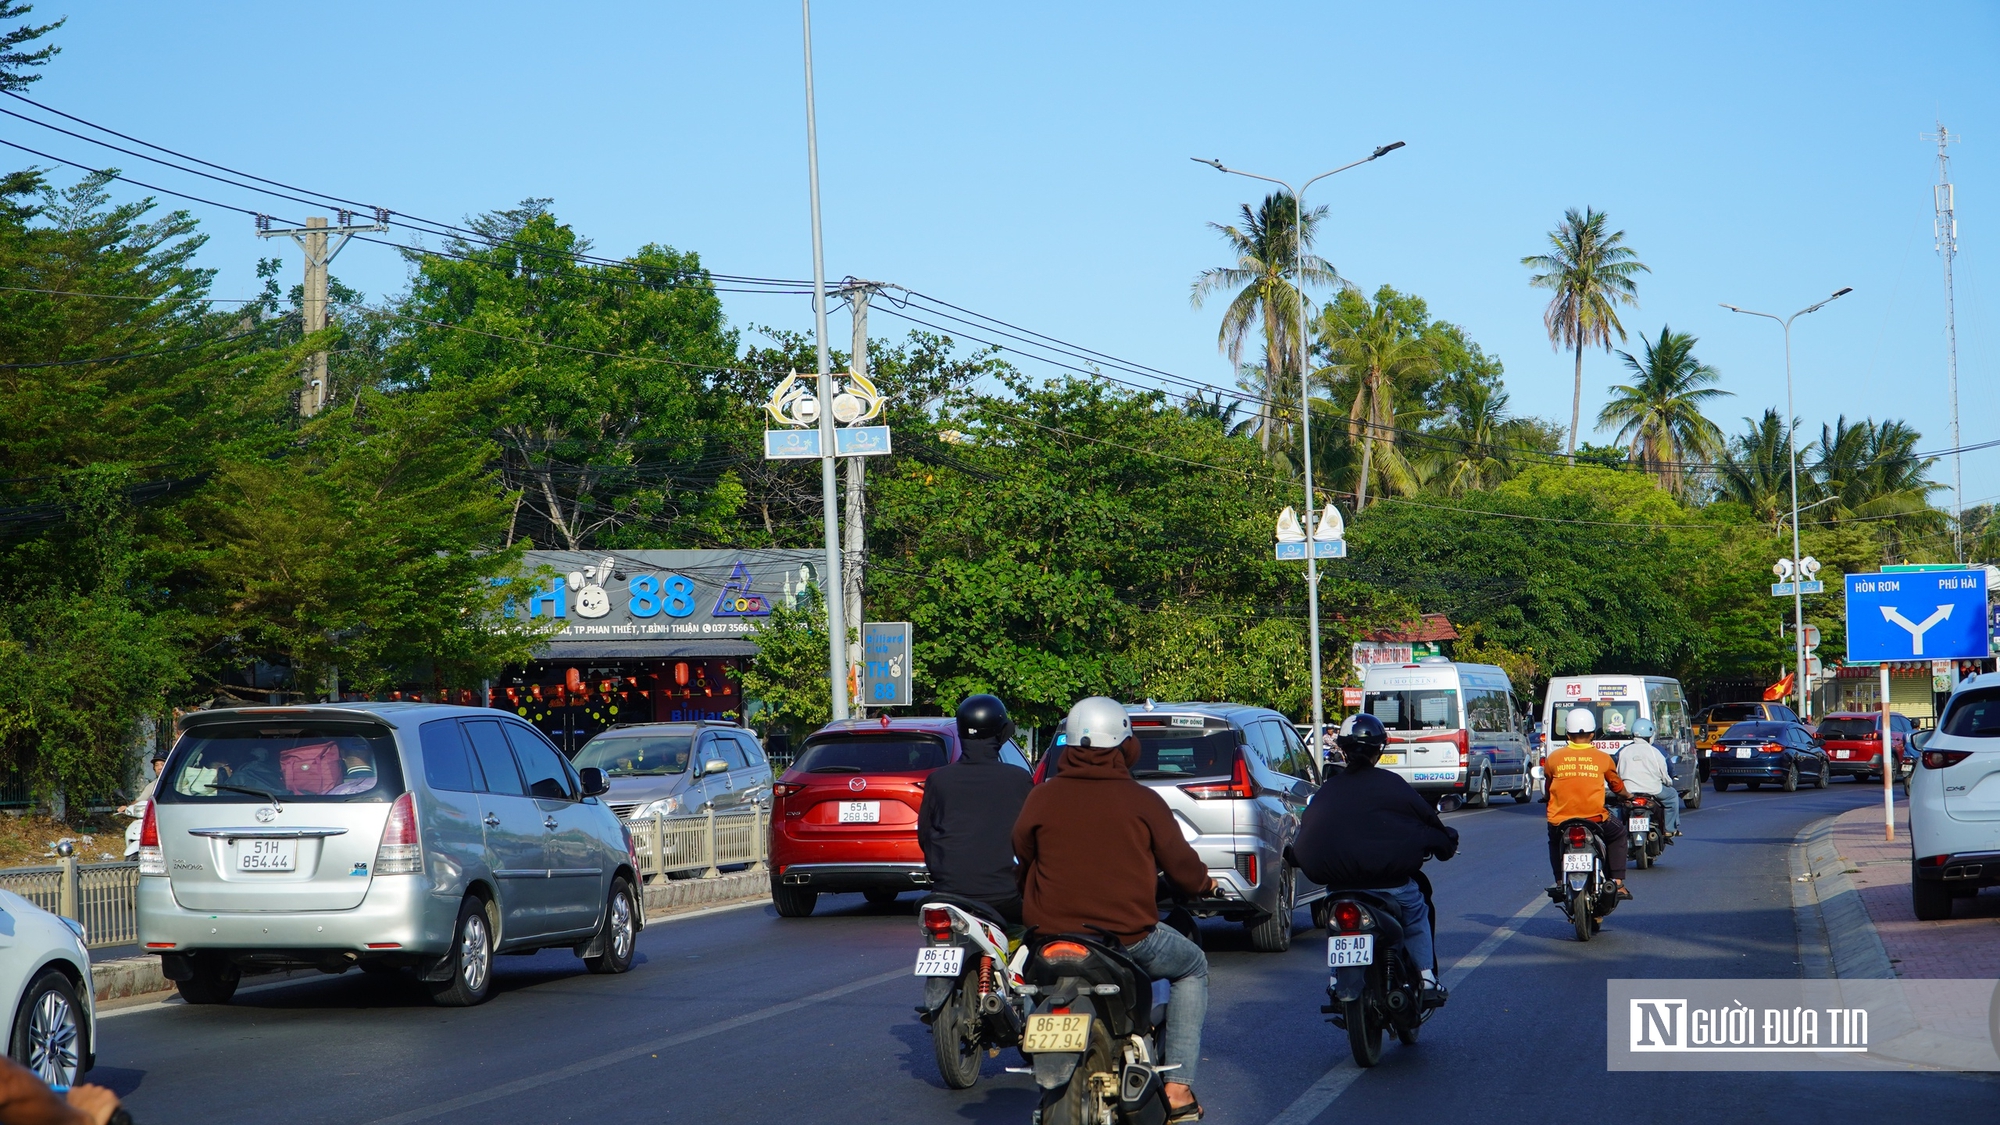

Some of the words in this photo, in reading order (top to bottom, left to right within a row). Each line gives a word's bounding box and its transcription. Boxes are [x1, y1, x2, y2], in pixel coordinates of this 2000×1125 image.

[1855, 579, 1875, 593] HÒN
[1878, 580, 1900, 592] RƠM
[1938, 575, 1958, 589] PHÚ
[1961, 575, 1977, 588] HÀI
[629, 574, 696, 618] 88
[575, 624, 610, 635] TP.PHAN
[612, 622, 639, 636] THIẾT,
[641, 623, 669, 634] T.BÌNH
[671, 623, 699, 635] THUẬN
[712, 624, 727, 633] 037
[729, 624, 748, 633] 3566
[866, 629, 904, 644] Billiard
[866, 661, 889, 678] TH
[874, 682, 896, 700] 88
[1190, 718, 1203, 726] ĐỒNG
[1557, 763, 1576, 771] HÙNG
[1579, 763, 1599, 772] THẢO
[850, 803, 867, 811] 65A
[843, 812, 874, 821] 268.96
[254, 841, 279, 853] 51H
[243, 856, 287, 868] 854.44
[1335, 937, 1366, 951] 86-AD
[924, 949, 956, 961] 86-C1
[1330, 950, 1369, 965] 061.24
[917, 961, 958, 974] 777.99
[1036, 1017, 1081, 1032] 86-B2
[1028, 1033, 1083, 1049] 527.94
